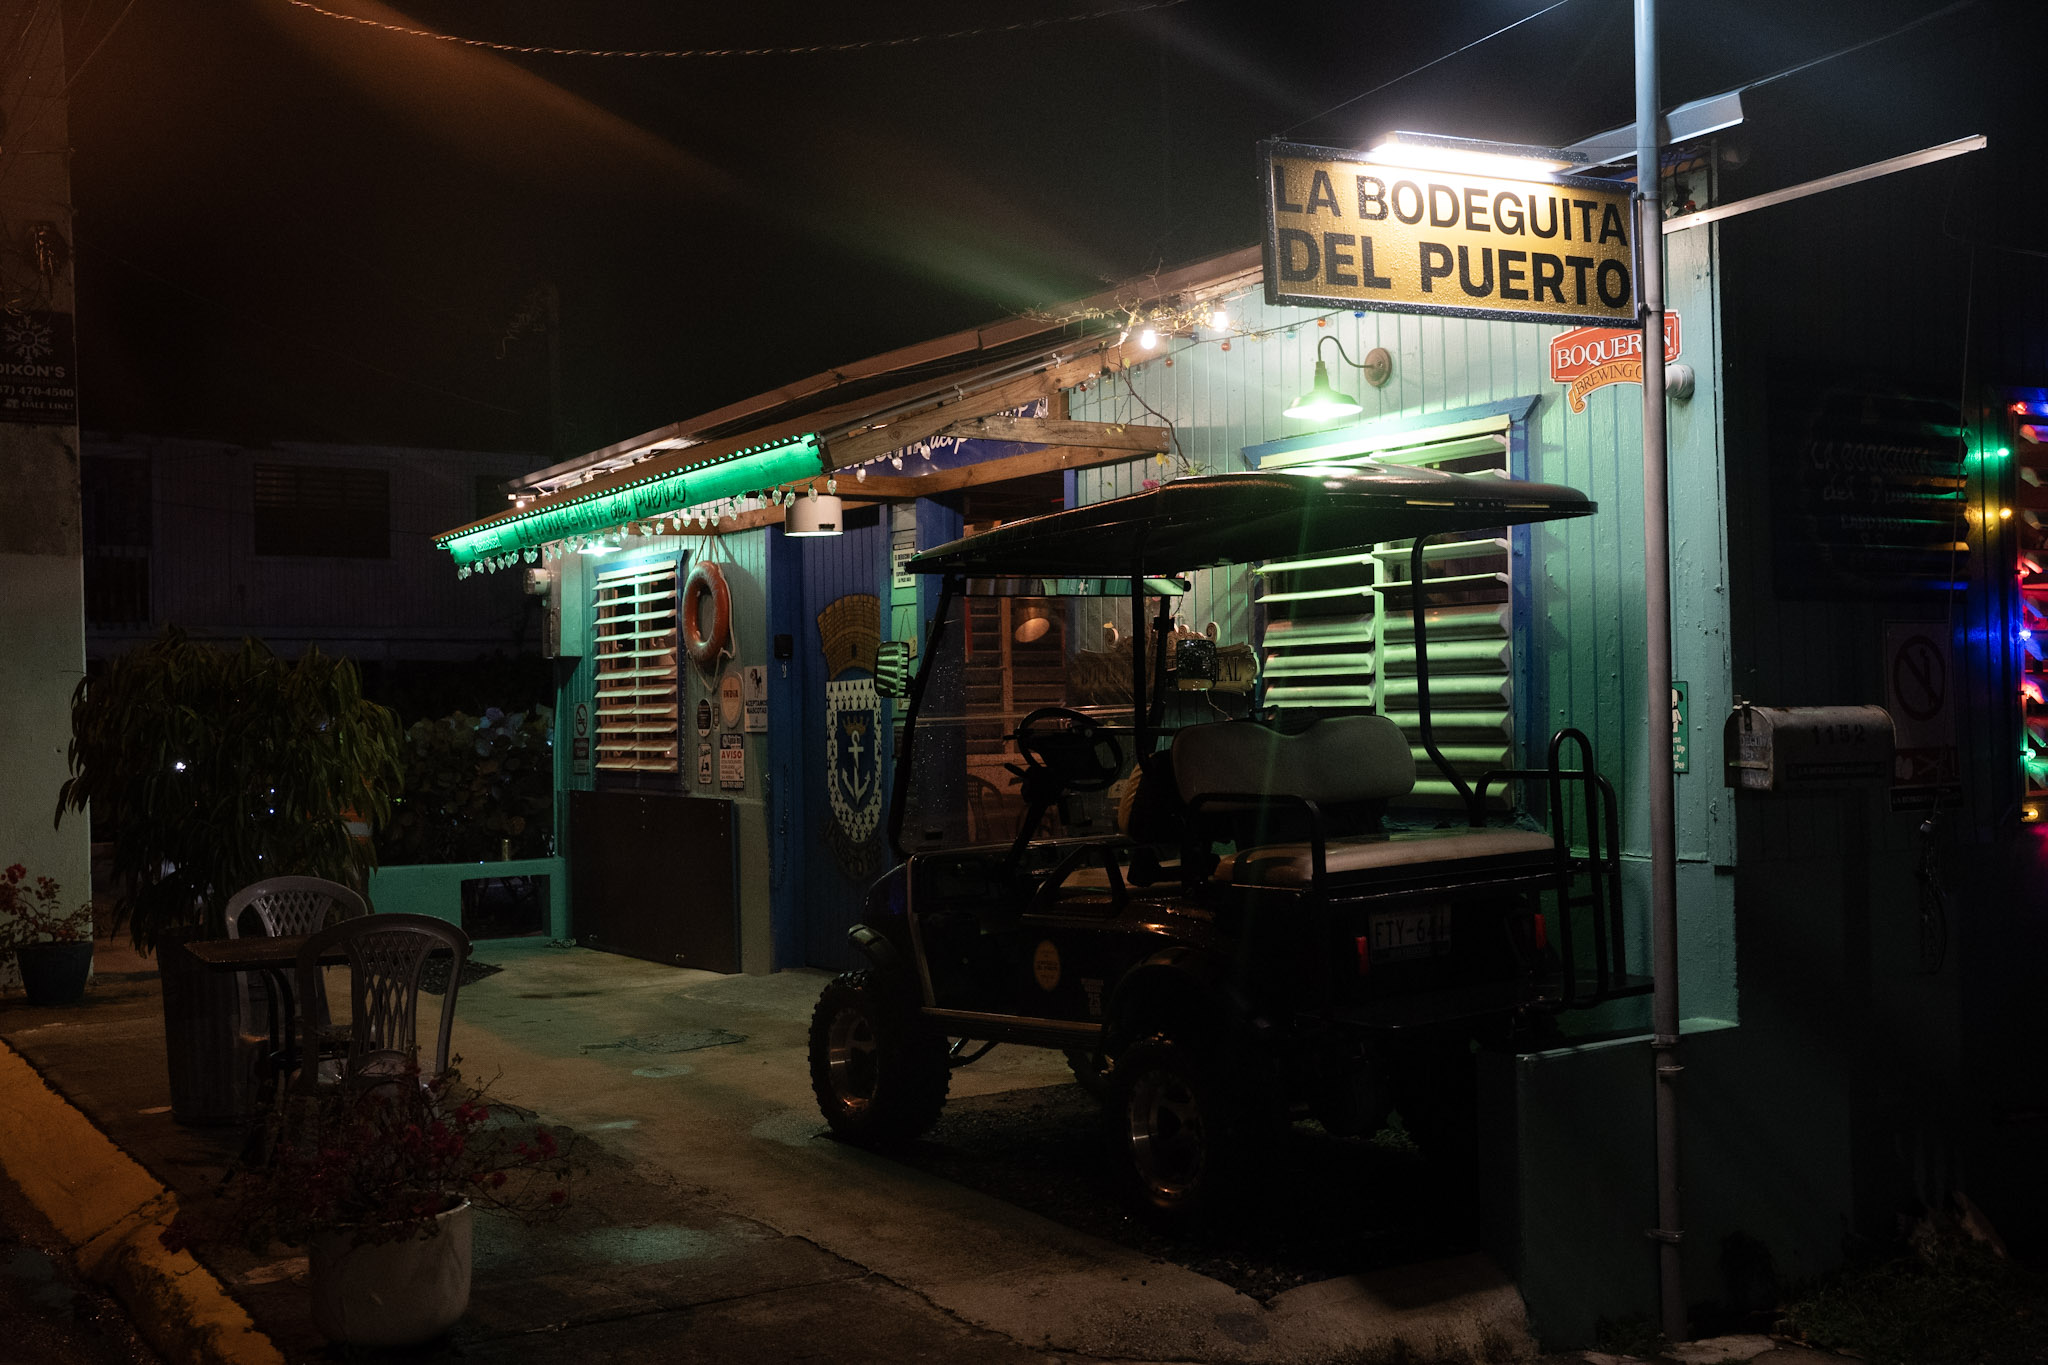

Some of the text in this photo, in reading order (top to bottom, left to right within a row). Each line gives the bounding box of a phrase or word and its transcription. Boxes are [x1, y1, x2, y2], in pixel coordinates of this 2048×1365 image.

[1274, 165, 1628, 247] LA BODEGUITA
[1278, 228, 1632, 308] DEL PUERTO
[1556, 326, 1672, 369] BOQUERN
[0, 363, 65, 378] DIXON'S
[1574, 363, 1632, 395] BREWING
[1812, 724, 1866, 745] 1152
[721, 750, 743, 759] AVISO
